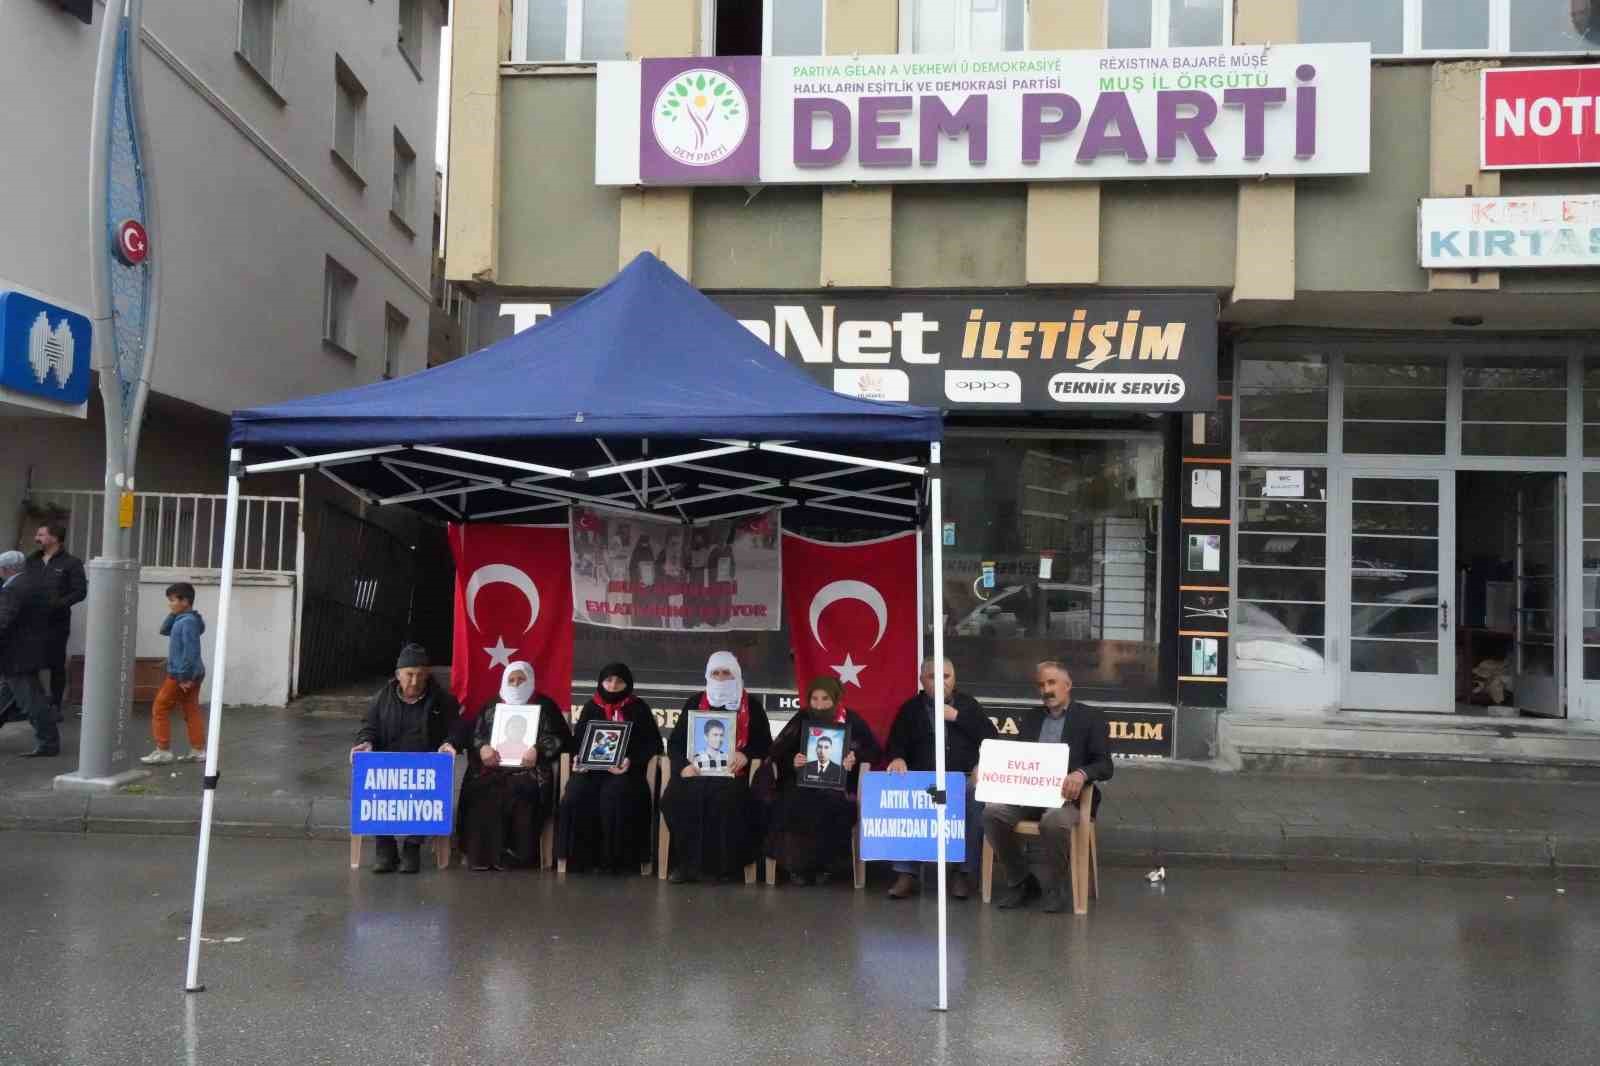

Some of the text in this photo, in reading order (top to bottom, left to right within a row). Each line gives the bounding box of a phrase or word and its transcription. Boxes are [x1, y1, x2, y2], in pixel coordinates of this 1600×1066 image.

[844, 65, 886, 77] GELAN
[889, 64, 898, 75] A
[793, 76, 1061, 94] HALKLARIN EŞİTLİK VE DEMOKRASİ PARTİSİ
[1099, 71, 1269, 93] MUŞ İL ÖRGÜTÜ
[793, 63, 1317, 167] DEM PARTİ
[672, 145, 695, 161] DEM
[961, 309, 1186, 370] İLETİŞİM
[955, 380, 1010, 391] oppo
[1054, 379, 1181, 395] TEKNİK SERVİS
[1007, 759, 1041, 771] EVLAT
[364, 768, 436, 790] ANNELER
[360, 793, 444, 822] DİRENİYOR
[880, 789, 910, 809] ARTIK
[863, 817, 928, 838] YAKAMIZDAN
